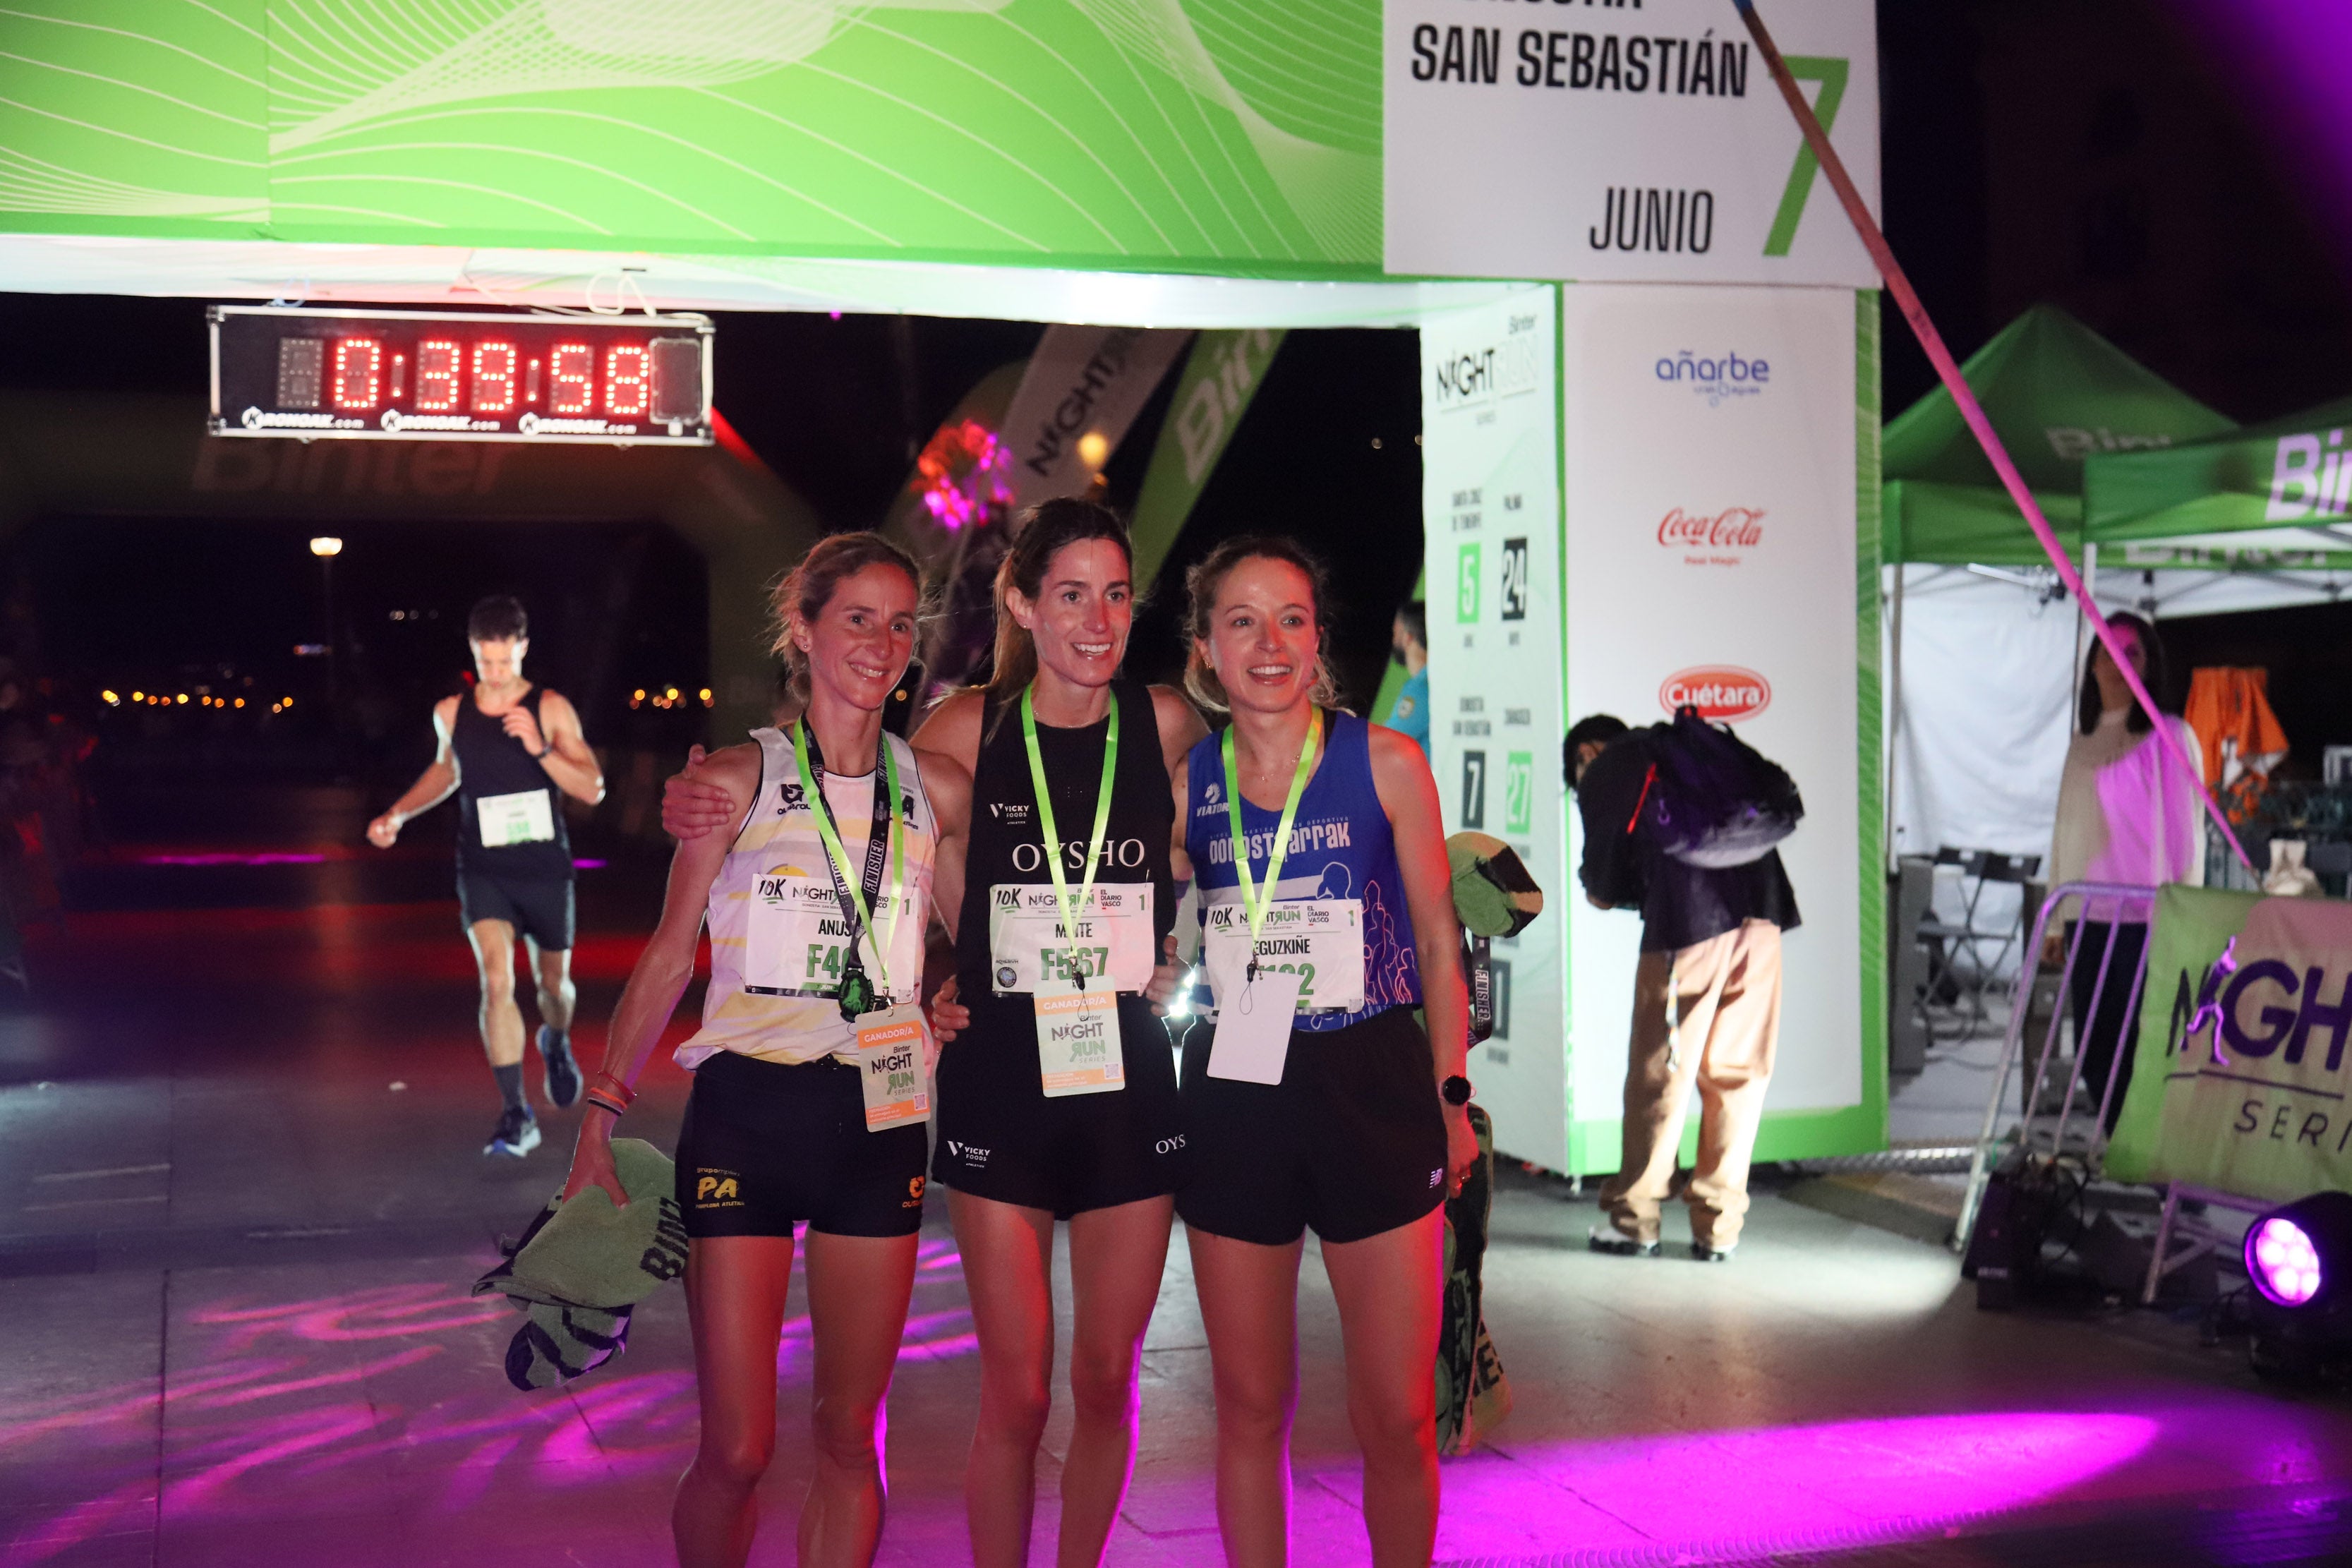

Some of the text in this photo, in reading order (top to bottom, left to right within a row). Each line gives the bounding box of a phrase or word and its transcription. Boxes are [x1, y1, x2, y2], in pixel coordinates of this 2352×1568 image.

[1411, 24, 1748, 97] SAN SEBASTIÁN
[1761, 54, 1850, 257] 7
[1590, 187, 1714, 253] JUNIO
[335, 339, 649, 414] 0:39:58
[1656, 351, 1769, 382] añarbe
[1463, 555, 1475, 616] 5
[1503, 548, 1526, 613] 24
[1669, 682, 1760, 706] Cuétara
[1468, 760, 1480, 821] 7
[1507, 764, 1530, 824] 27
[1196, 802, 1229, 817] VIATOR
[1307, 816, 1349, 826] DEPORTIVO
[864, 839, 885, 894] FINISHER
[758, 879, 835, 902] 10K NIGHT
[996, 888, 1022, 909] 10K
[904, 898, 910, 915] 1
[1139, 894, 1145, 911] 1
[1210, 906, 1234, 928] 10K
[1348, 910, 1354, 927] 1
[1056, 922, 1092, 938] MITE
[1040, 947, 1109, 980] F567
[1043, 996, 1107, 1011] GANADOR/A
[1475, 969, 1491, 1020] FINISHER
[864, 1027, 914, 1043] GANADOR/A
[1051, 1022, 1104, 1041] NIGHT
[893, 1044, 911, 1054] Binter
[871, 1054, 912, 1075] NIGHT
[894, 1087, 915, 1097] SERIES
[964, 1146, 991, 1157] VICKY
[697, 1176, 738, 1200] PA
